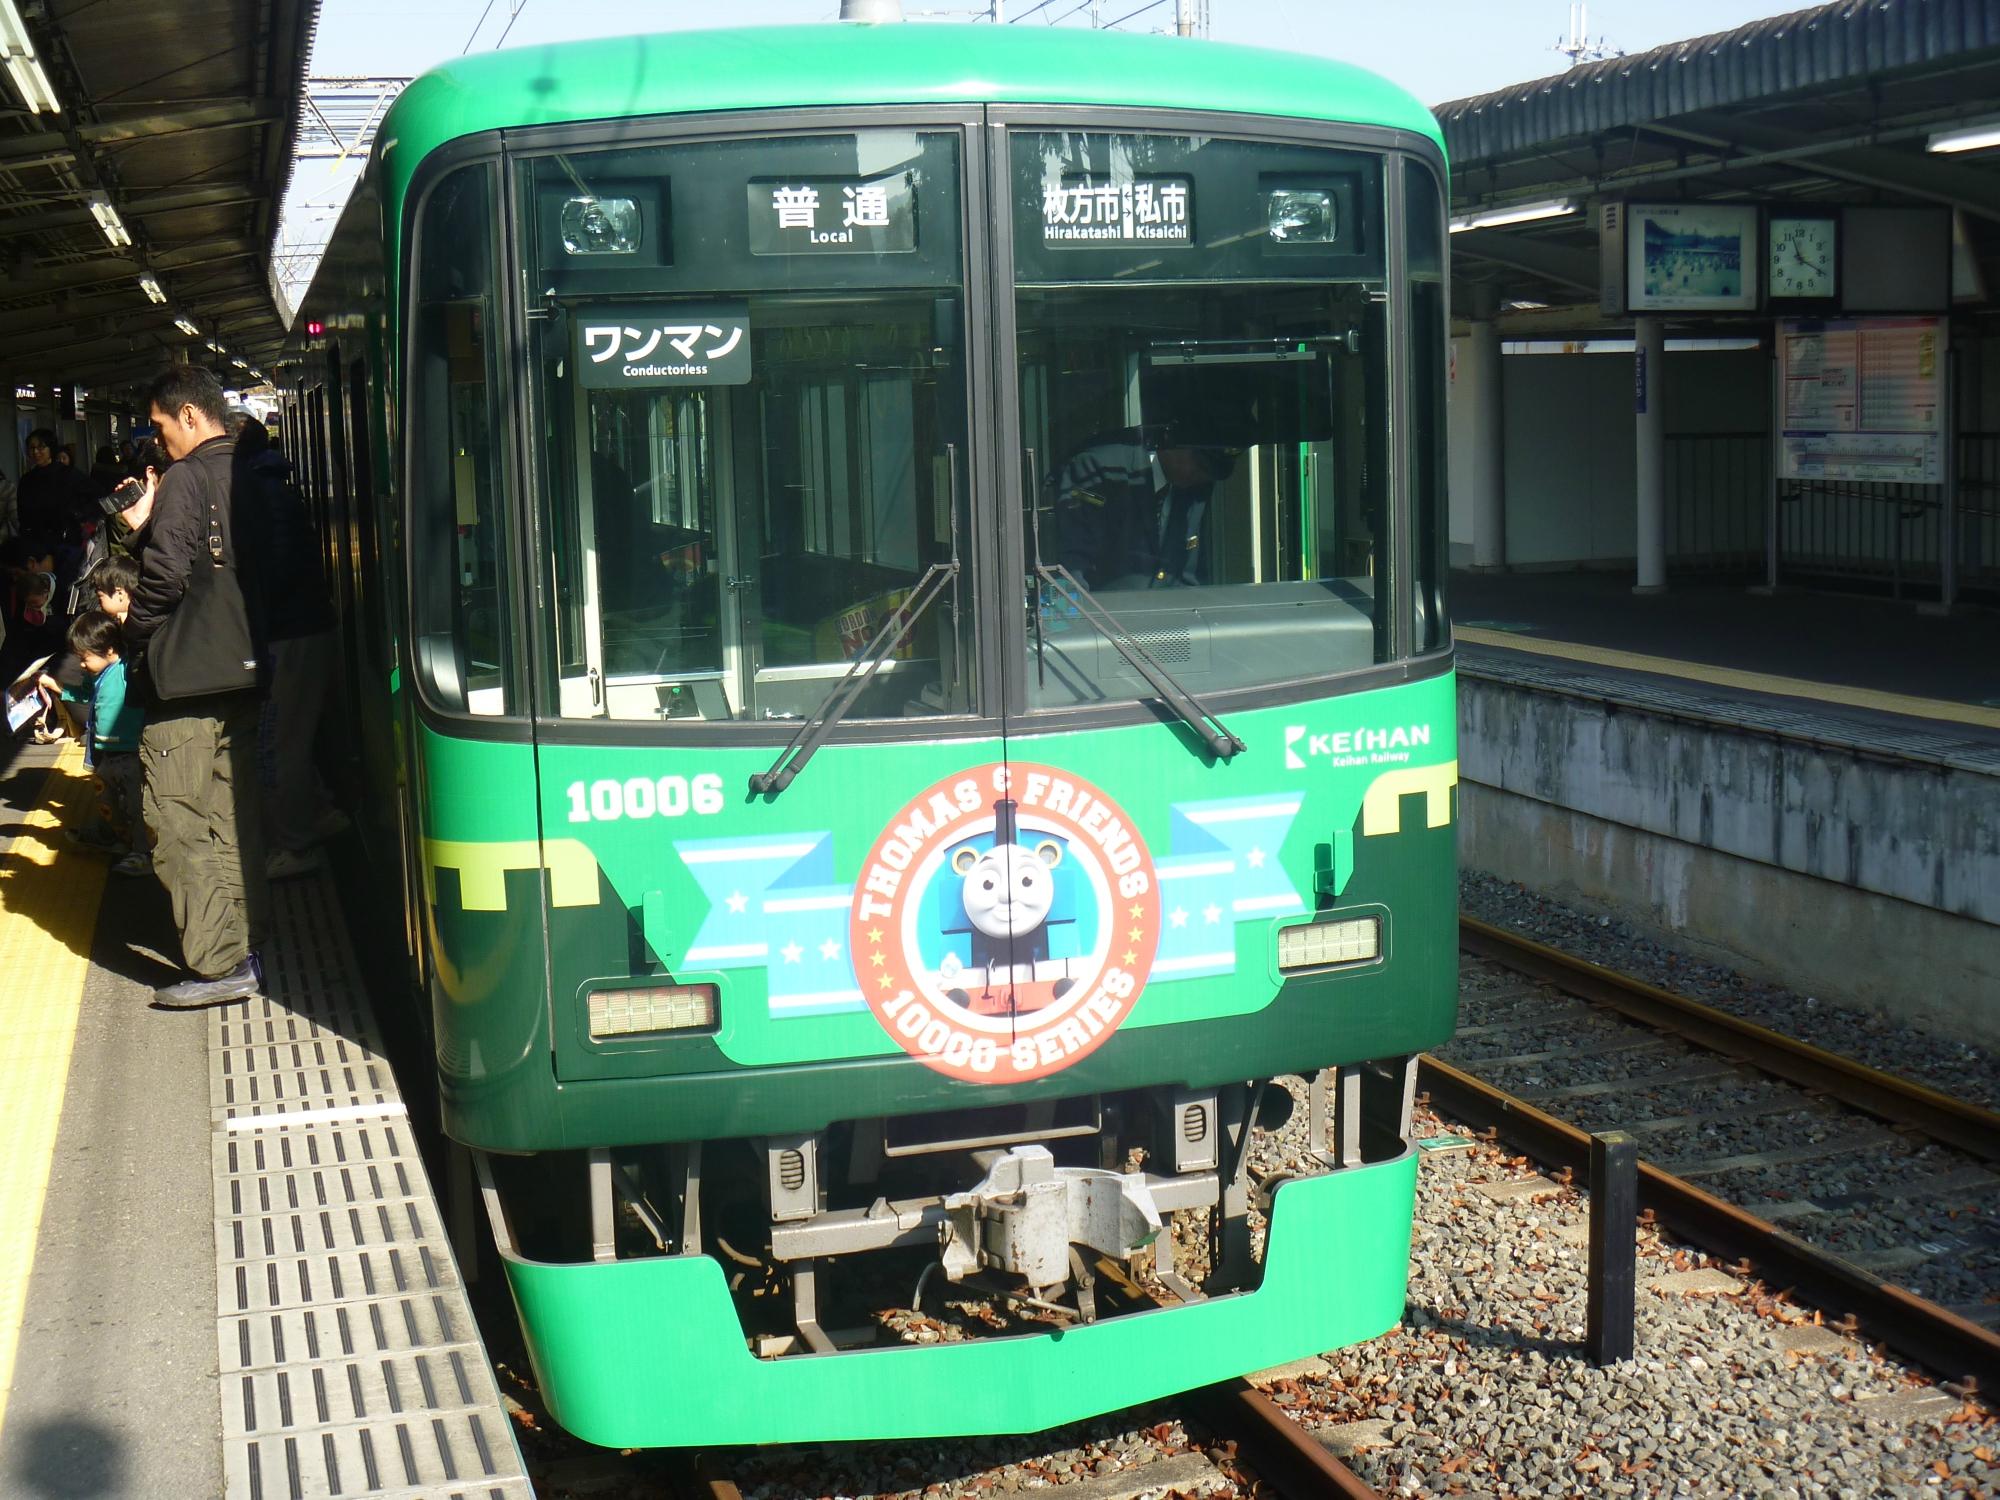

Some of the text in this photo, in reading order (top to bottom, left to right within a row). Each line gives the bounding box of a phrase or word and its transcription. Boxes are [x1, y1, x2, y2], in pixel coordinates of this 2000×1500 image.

[772, 186, 890, 229] 普通
[1043, 182, 1187, 224] 枚方市 私市
[810, 228, 853, 244] Local
[1044, 225, 1187, 239] Hirakatashi Kisaichi
[1784, 233, 1791, 242] 11
[1795, 229, 1805, 238] 12
[1776, 243, 1786, 252] 10
[1816, 242, 1823, 251] 2
[1773, 255, 1780, 265] 9
[1819, 255, 1826, 265] 3
[1776, 268, 1784, 278] 8
[1786, 278, 1792, 287] 7
[585, 324, 743, 363] ワンマン
[622, 363, 708, 377] Conductorless
[1308, 723, 1431, 756] KEIHAN
[1333, 751, 1410, 768] Keihan Railway
[566, 772, 725, 823] 10006
[859, 778, 982, 921] THOMAS
[1023, 772, 1149, 899] FRIENDS
[881, 966, 1136, 1073] 10000 SERIES
